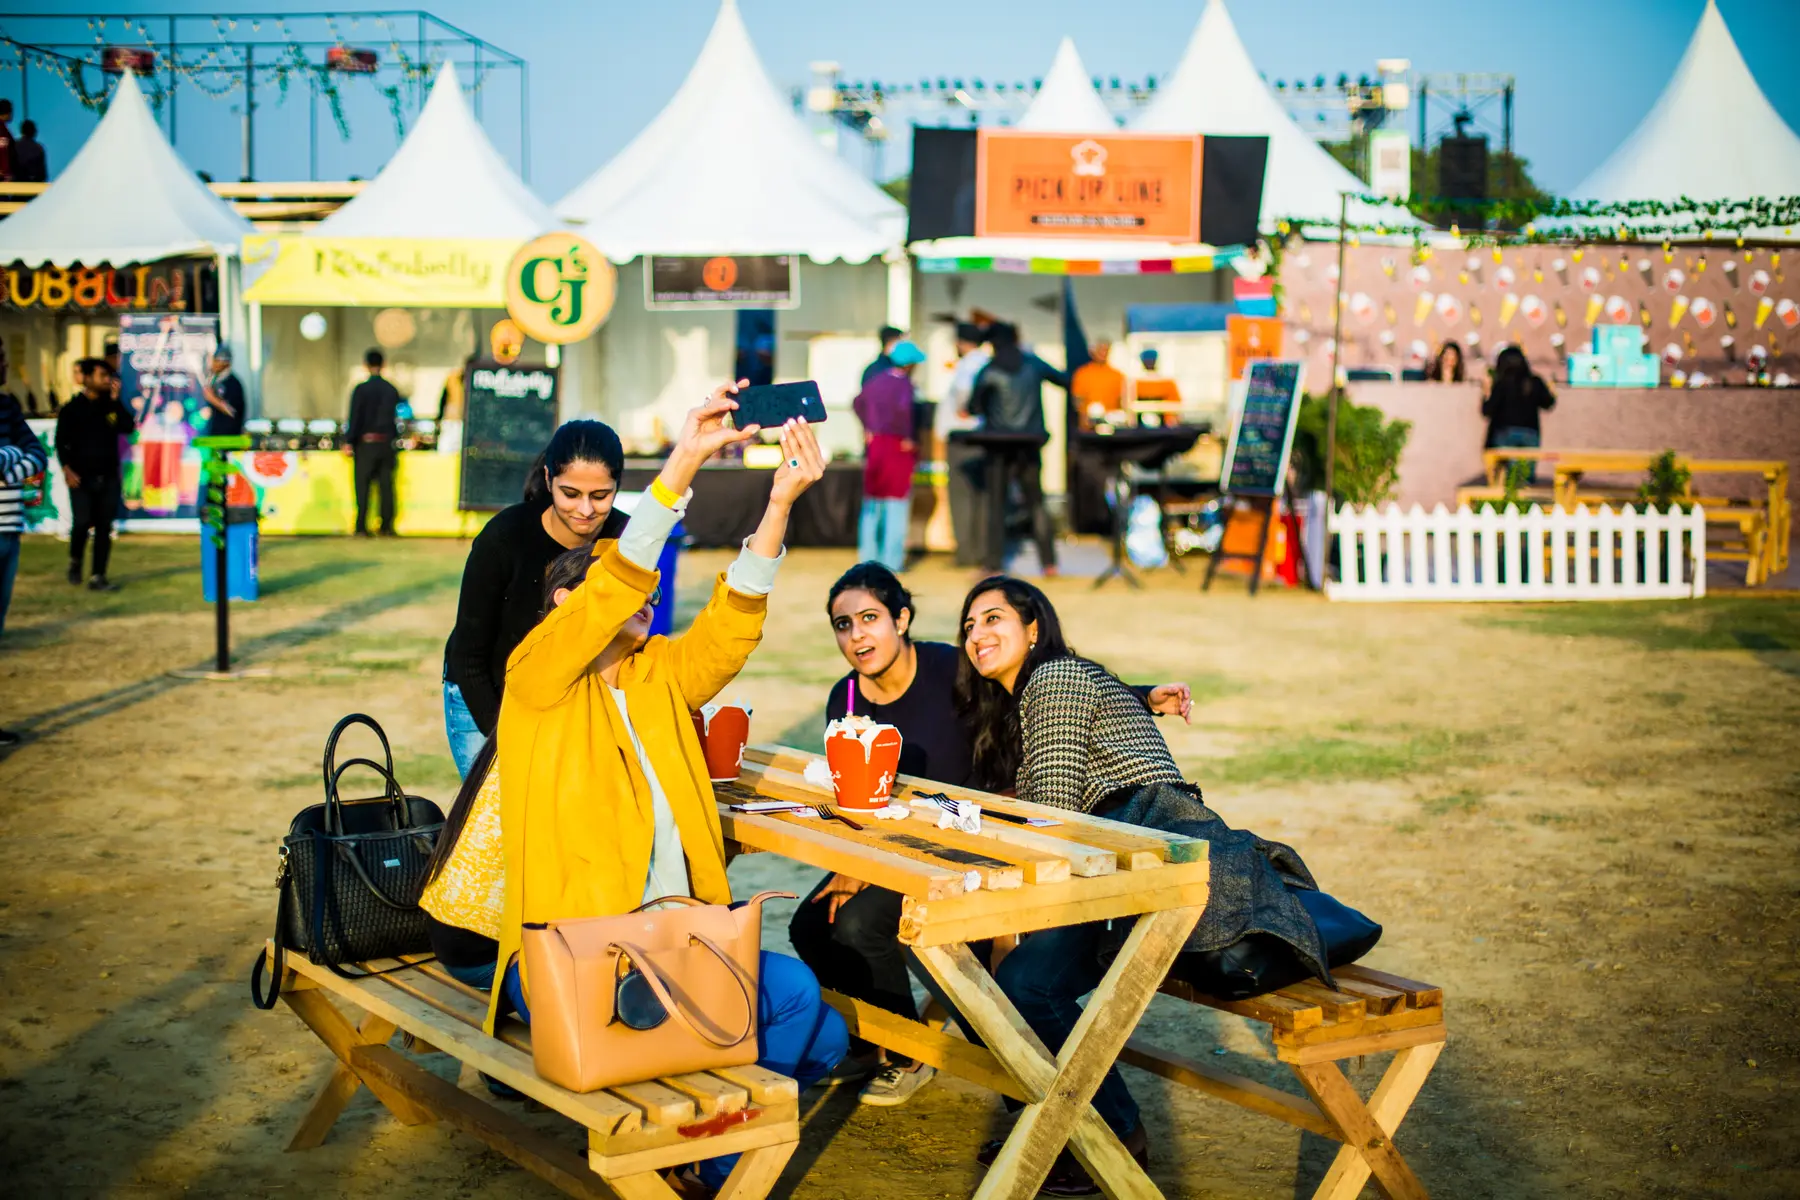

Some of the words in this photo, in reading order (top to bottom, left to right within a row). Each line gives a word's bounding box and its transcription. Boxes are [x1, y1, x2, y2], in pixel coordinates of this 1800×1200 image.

[1013, 177, 1065, 202] PICK
[1078, 178, 1105, 203] UP
[1115, 179, 1162, 204] LINE
[0, 265, 186, 310] UBBLIN
